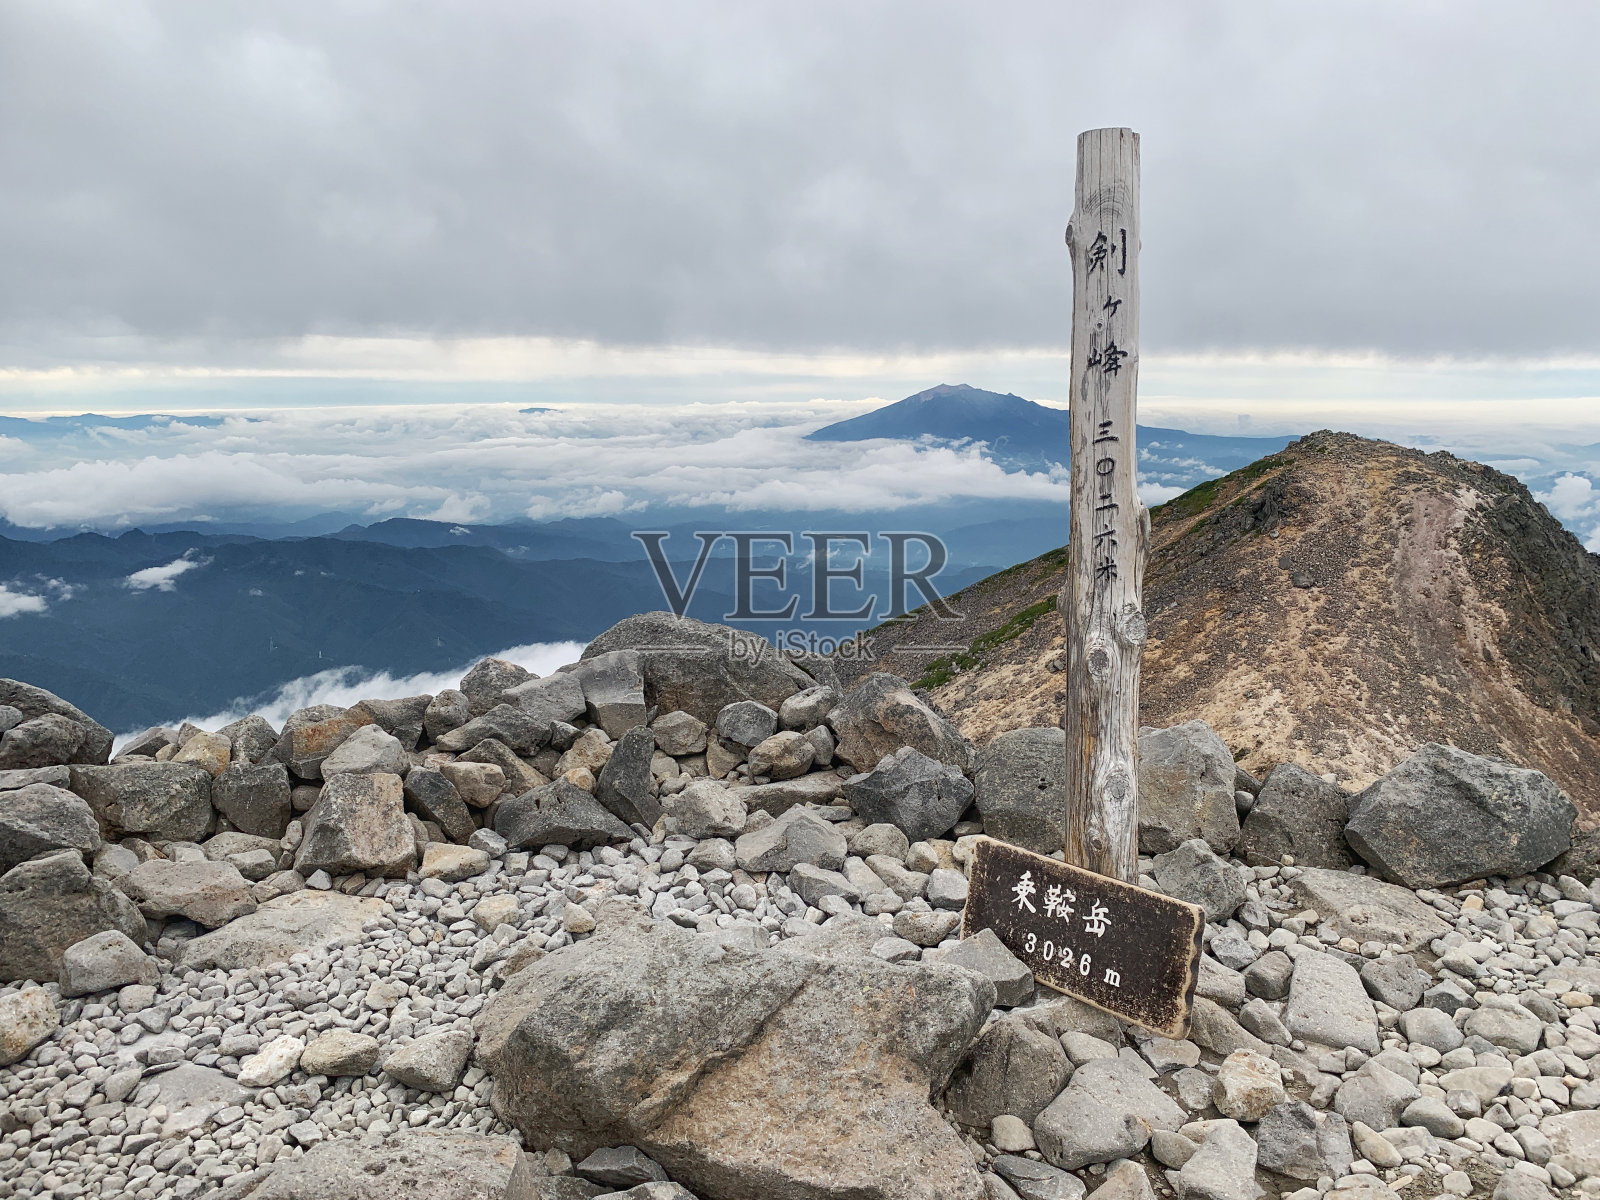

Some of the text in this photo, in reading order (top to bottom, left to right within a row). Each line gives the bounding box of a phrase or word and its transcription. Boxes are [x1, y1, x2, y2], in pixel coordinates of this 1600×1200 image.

[1011, 870, 1112, 938] 乗鞍岳
[1024, 932, 1092, 976] 3026
